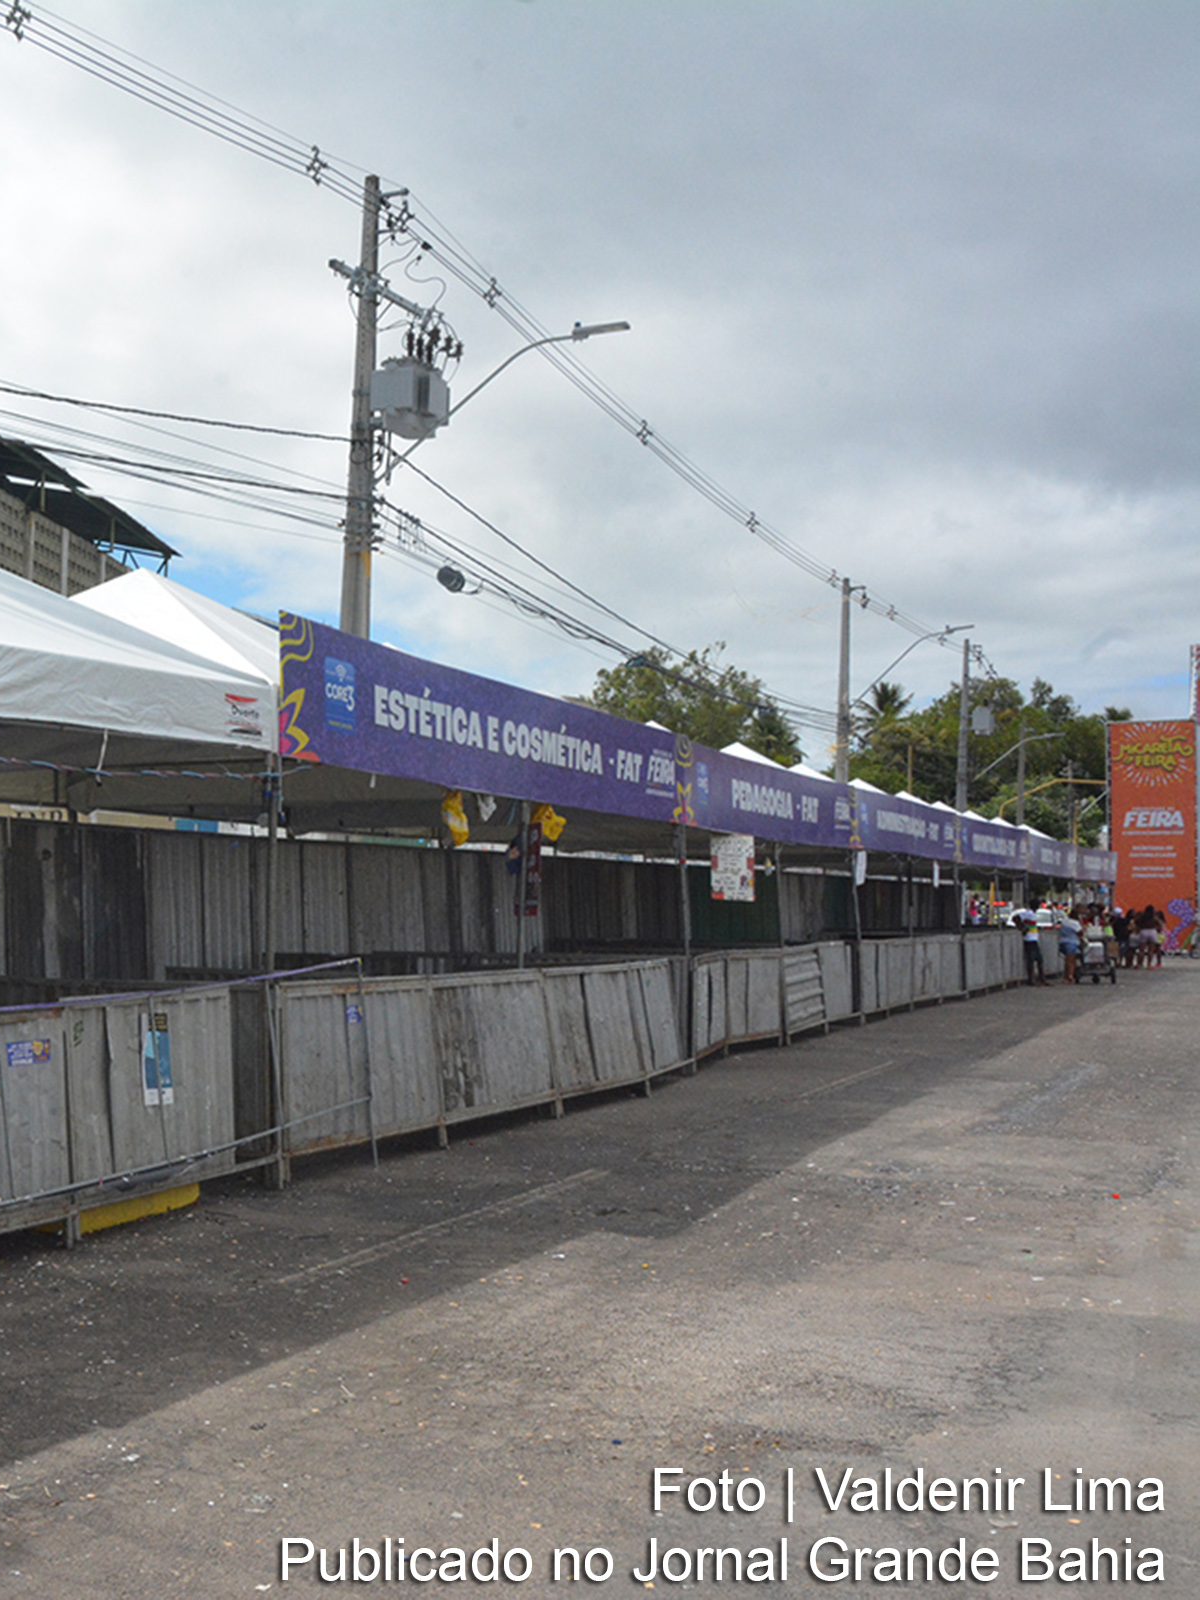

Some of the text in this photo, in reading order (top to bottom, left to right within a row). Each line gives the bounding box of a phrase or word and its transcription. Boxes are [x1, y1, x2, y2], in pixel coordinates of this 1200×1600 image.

[374, 686, 484, 749] ESTÉTICA
[486, 715, 499, 753] E
[502, 720, 603, 776] COSMÉTICA
[616, 749, 643, 783] FAT
[1112, 735, 1193, 763] MICARETA
[647, 755, 676, 786] FEIRA
[1134, 755, 1178, 772] FEIRA
[731, 778, 794, 820] PEDAGOGIA
[801, 796, 820, 824] FAT
[1123, 810, 1185, 828] FEIRA
